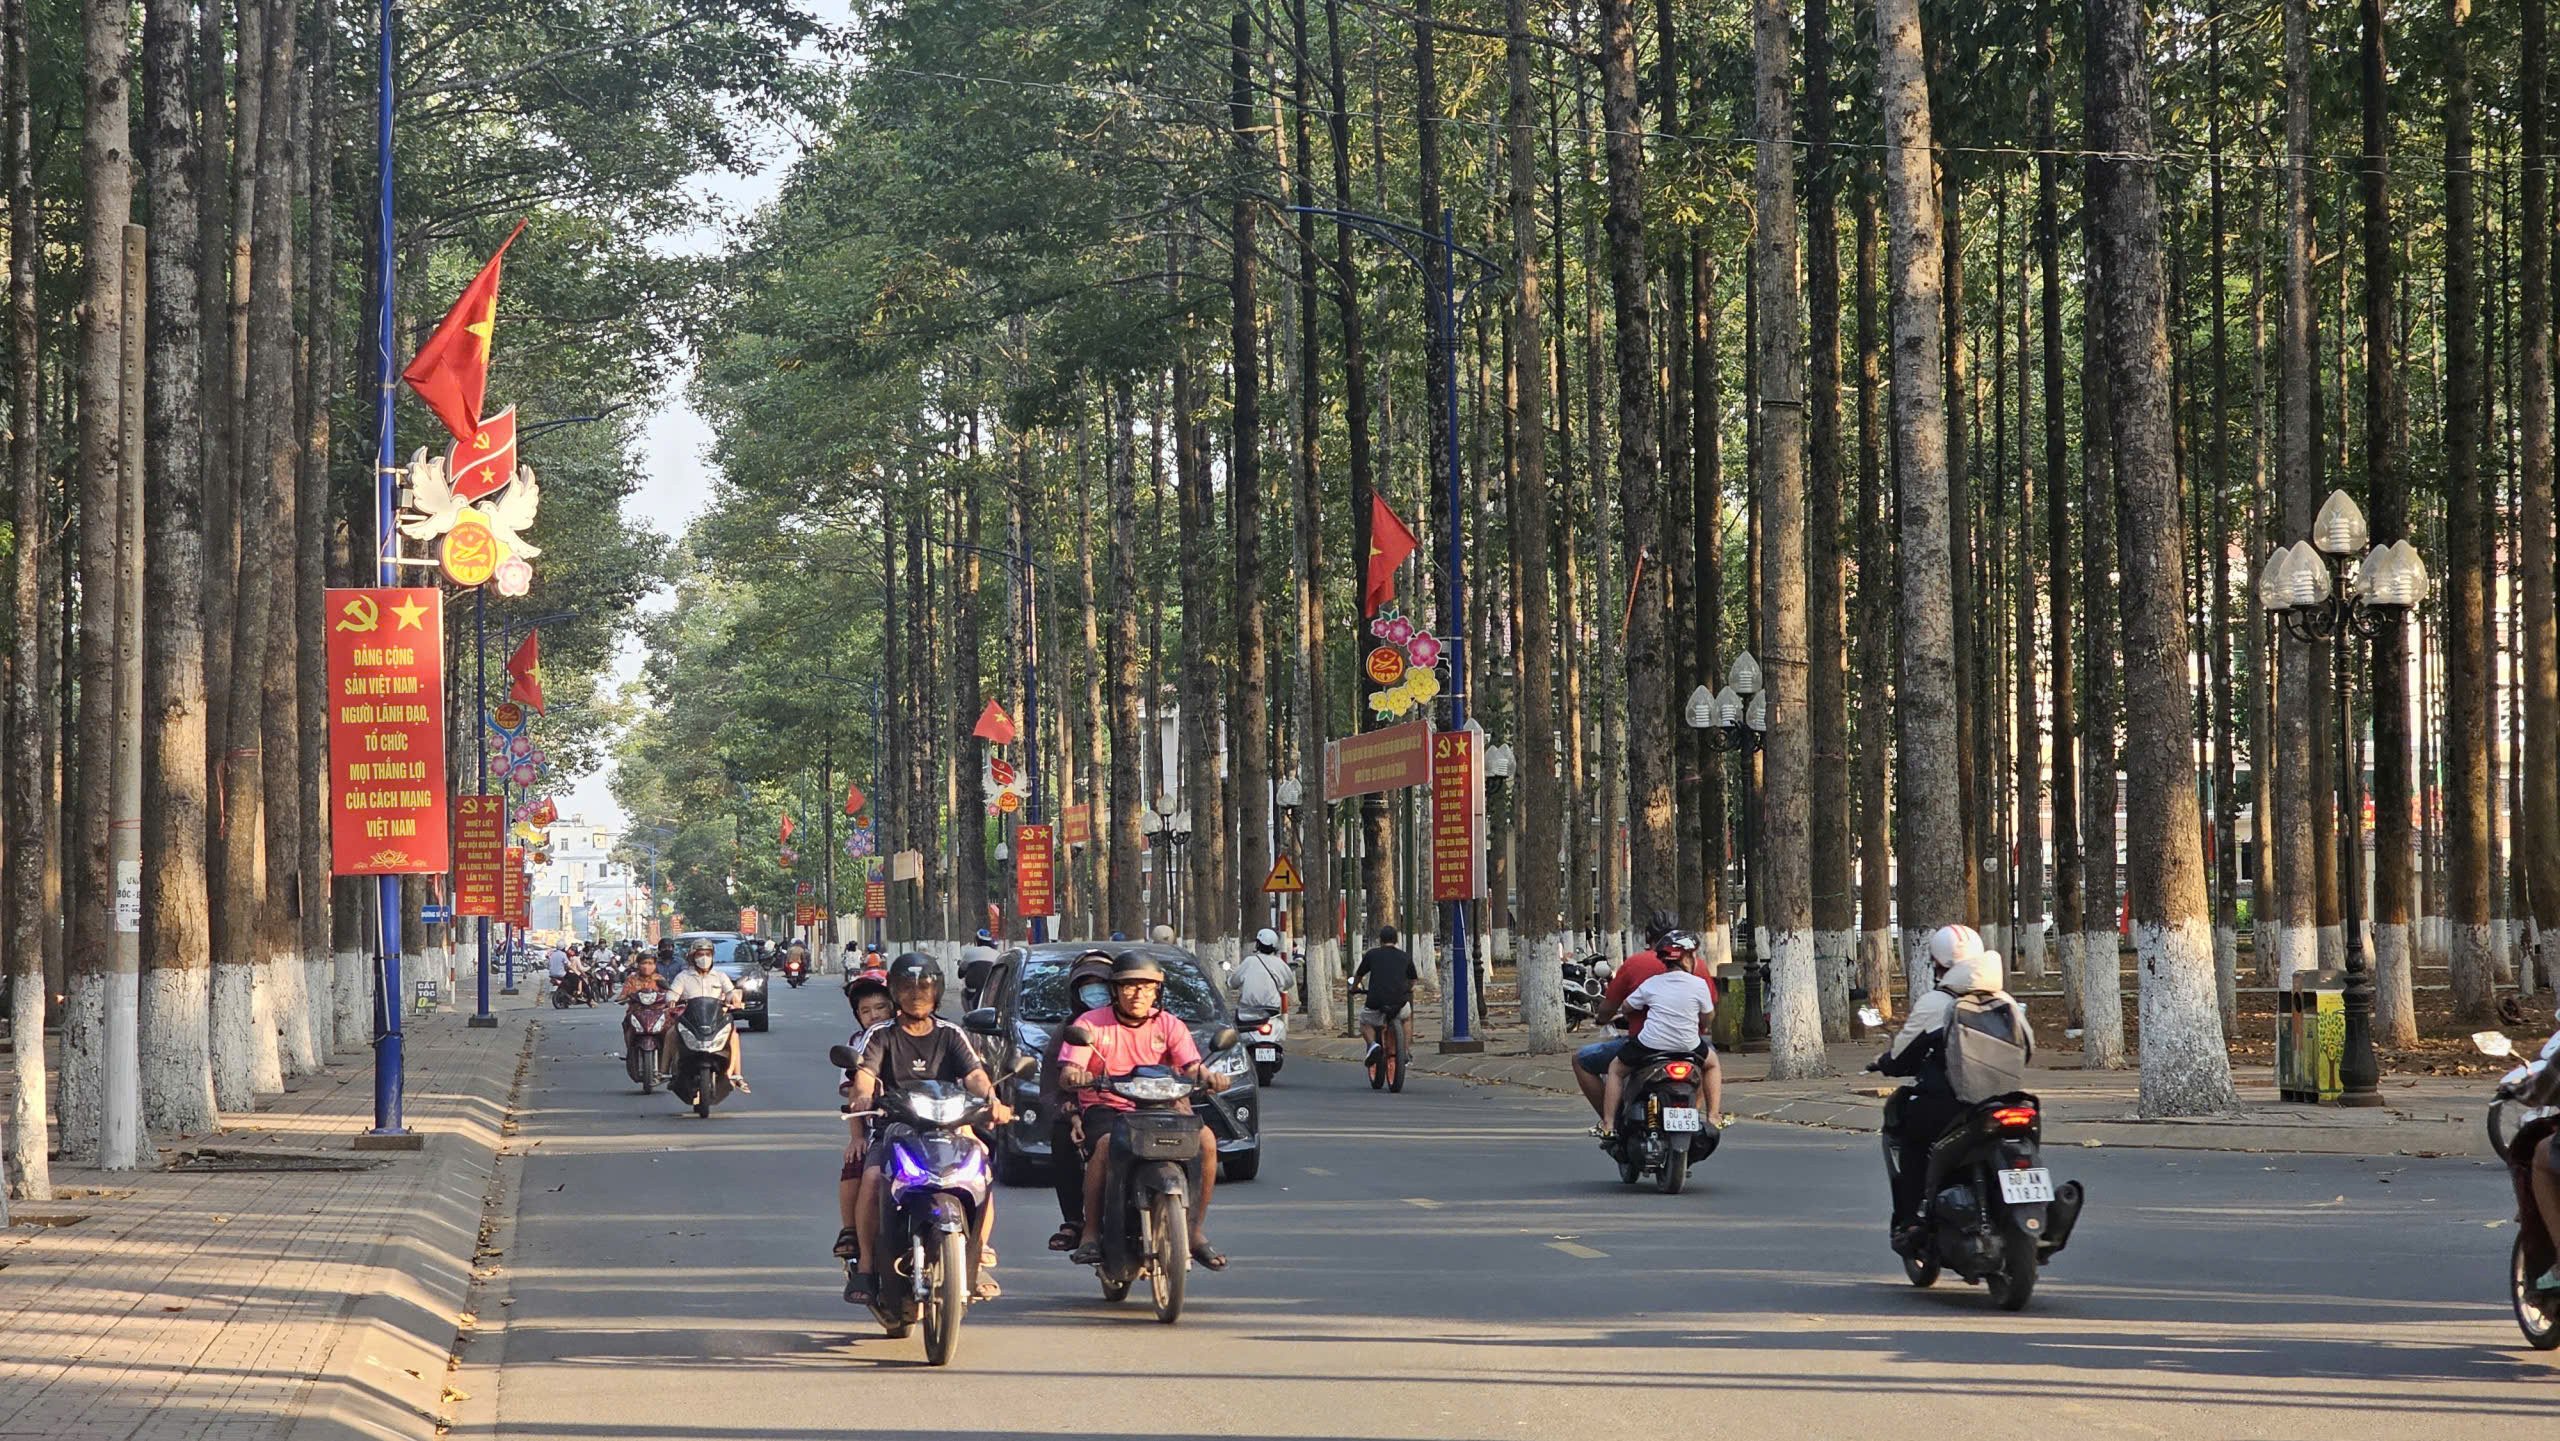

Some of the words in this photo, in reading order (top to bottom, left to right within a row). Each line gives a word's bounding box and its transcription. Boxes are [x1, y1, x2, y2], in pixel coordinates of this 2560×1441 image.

[354, 643, 383, 666] ĐẢNG
[385, 645, 414, 669] CỘNG
[345, 672, 367, 695] SẢN
[369, 673, 391, 698] VIỆT
[393, 677, 418, 694] NAM
[341, 702, 374, 724] NGƯỜI
[376, 702, 403, 723] LÃNH
[406, 705, 430, 726] ĐẠO,
[365, 728, 378, 751] TỔ
[381, 730, 408, 751] CHỨC
[350, 763, 370, 784] MỌI
[372, 756, 407, 780] THẮNG
[409, 760, 426, 782] LỢI
[345, 786, 367, 809] CỦA
[369, 787, 398, 808] CÁCH
[400, 790, 432, 811] MẠNG
[366, 816, 388, 840] VIỆT
[391, 819, 416, 836] NAM
